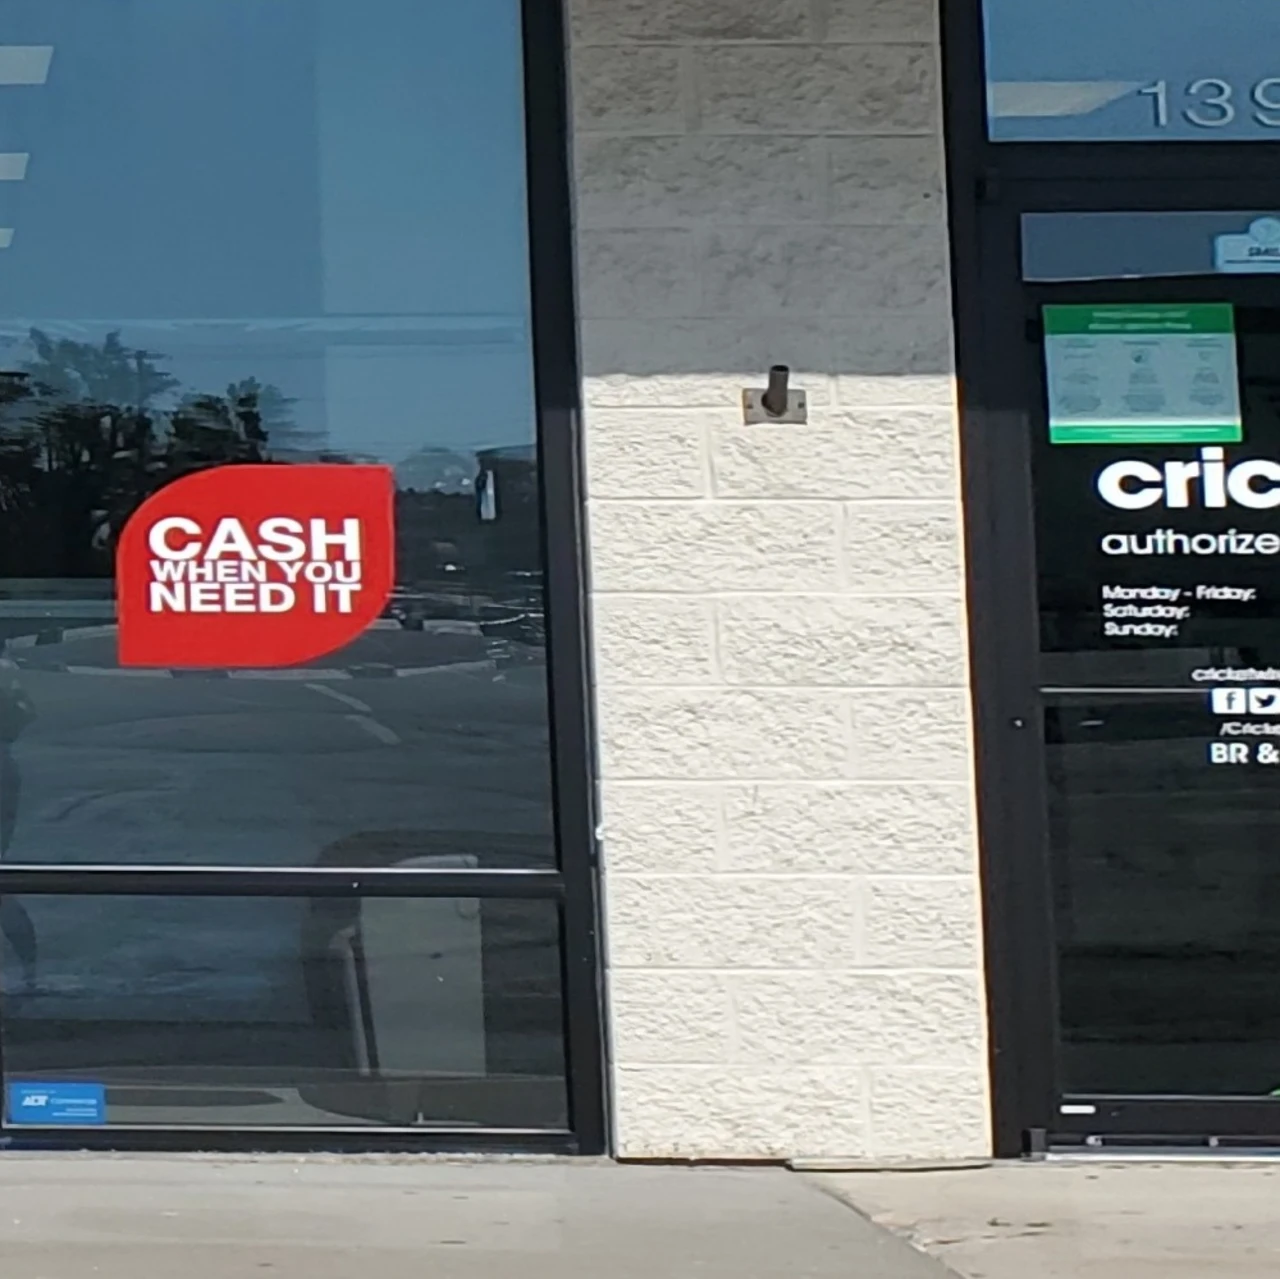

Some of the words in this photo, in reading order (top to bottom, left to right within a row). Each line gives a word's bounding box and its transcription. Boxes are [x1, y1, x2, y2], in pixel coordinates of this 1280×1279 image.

[1097, 446, 1280, 510] cric
[148, 516, 362, 561] CASH
[149, 560, 267, 582] WHEN
[277, 561, 362, 583] YOU
[149, 582, 296, 613] NEED
[313, 583, 362, 613] IT
[1102, 585, 1181, 602] Monday
[1210, 742, 1249, 764] BR
[1256, 742, 1280, 764] &
